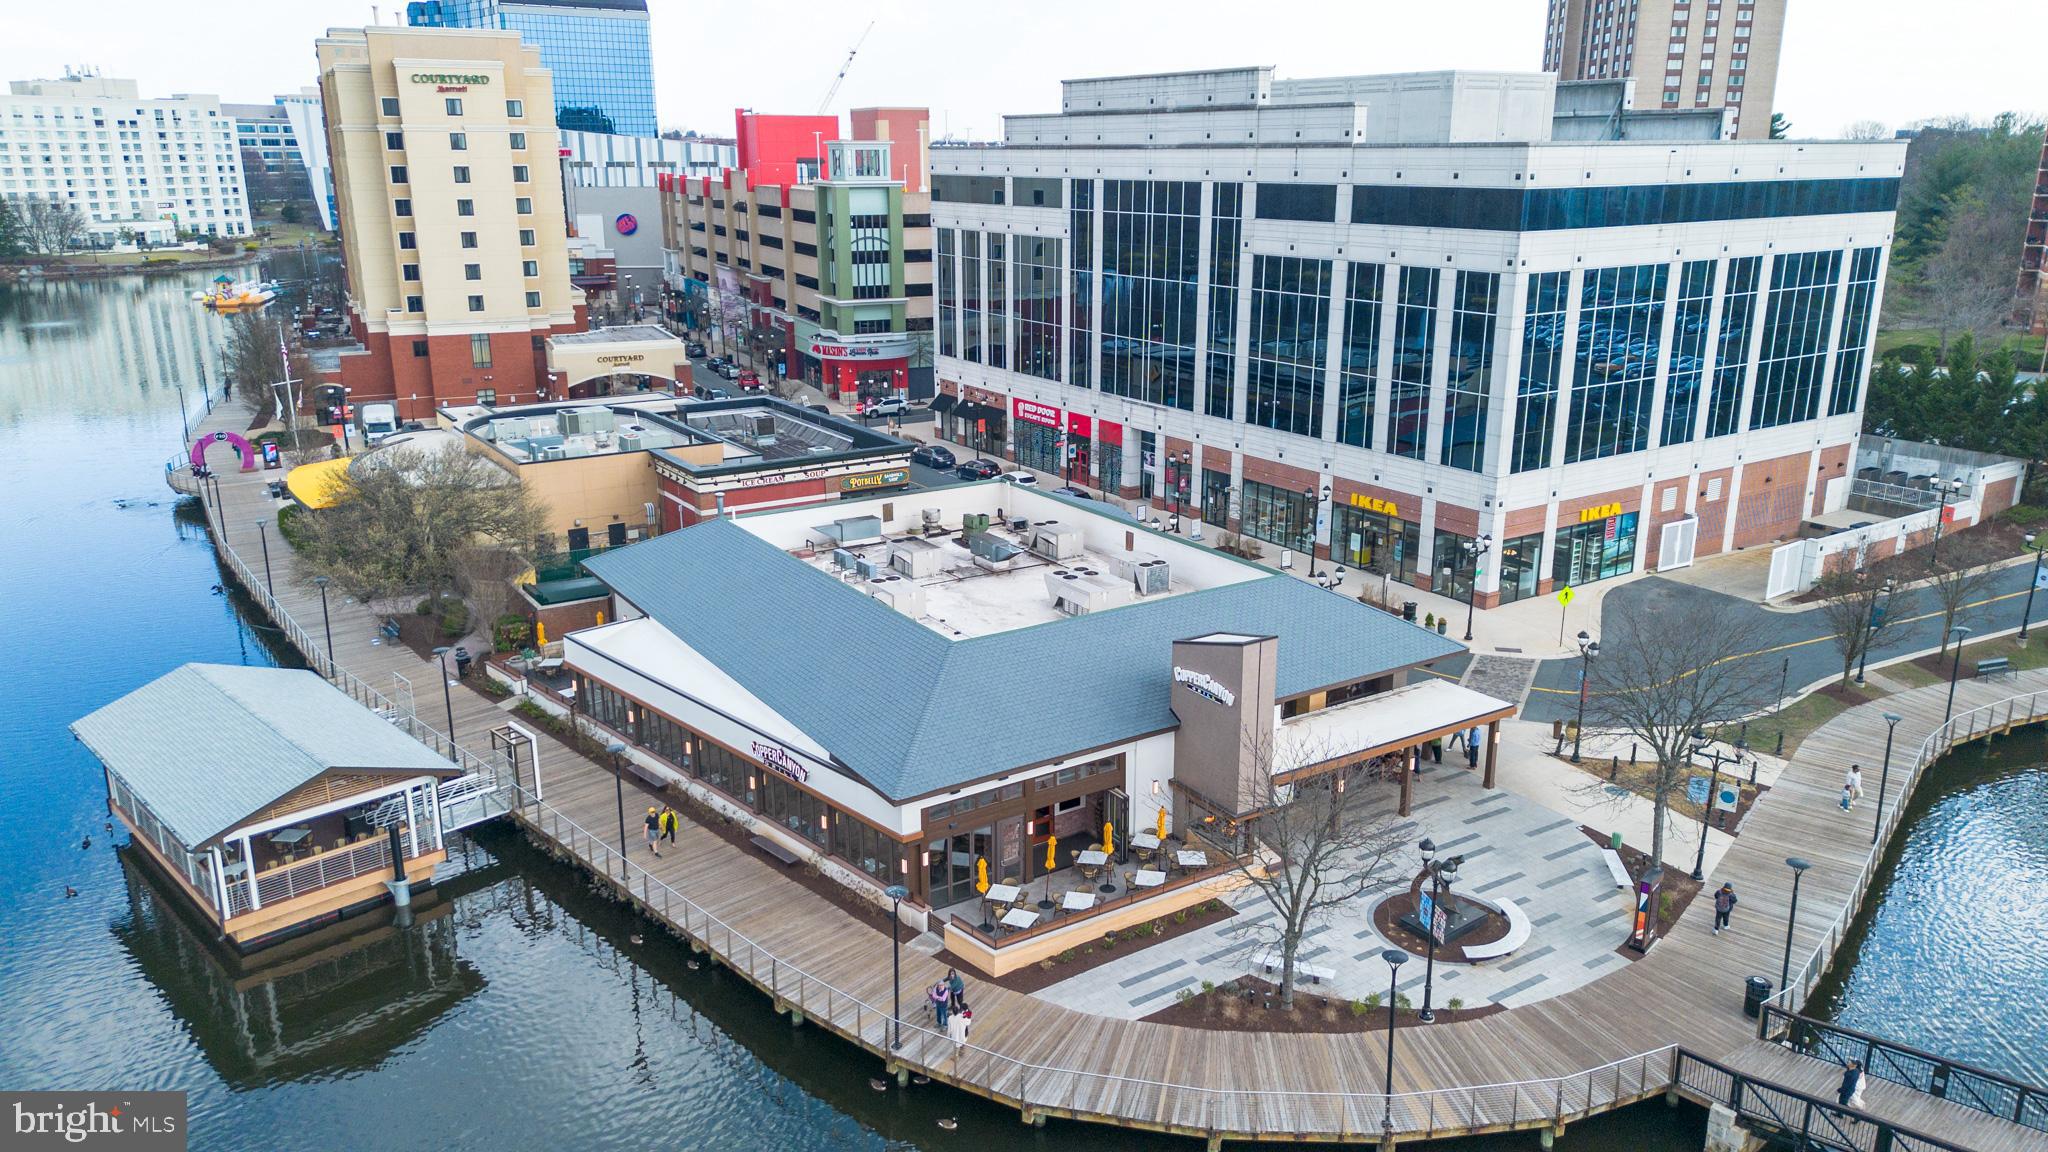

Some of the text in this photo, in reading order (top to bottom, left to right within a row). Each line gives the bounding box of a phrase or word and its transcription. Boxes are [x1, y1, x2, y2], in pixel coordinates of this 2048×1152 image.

[411, 74, 490, 84] COURTYARD
[597, 354, 645, 363] COURTYARD
[1024, 403, 1056, 418] RED DOOR
[742, 470, 826, 487] ICE CREAM SOUP
[850, 474, 883, 489] POTBELLY
[1350, 492, 1398, 516] IKEA
[1580, 502, 1622, 523] IKEA
